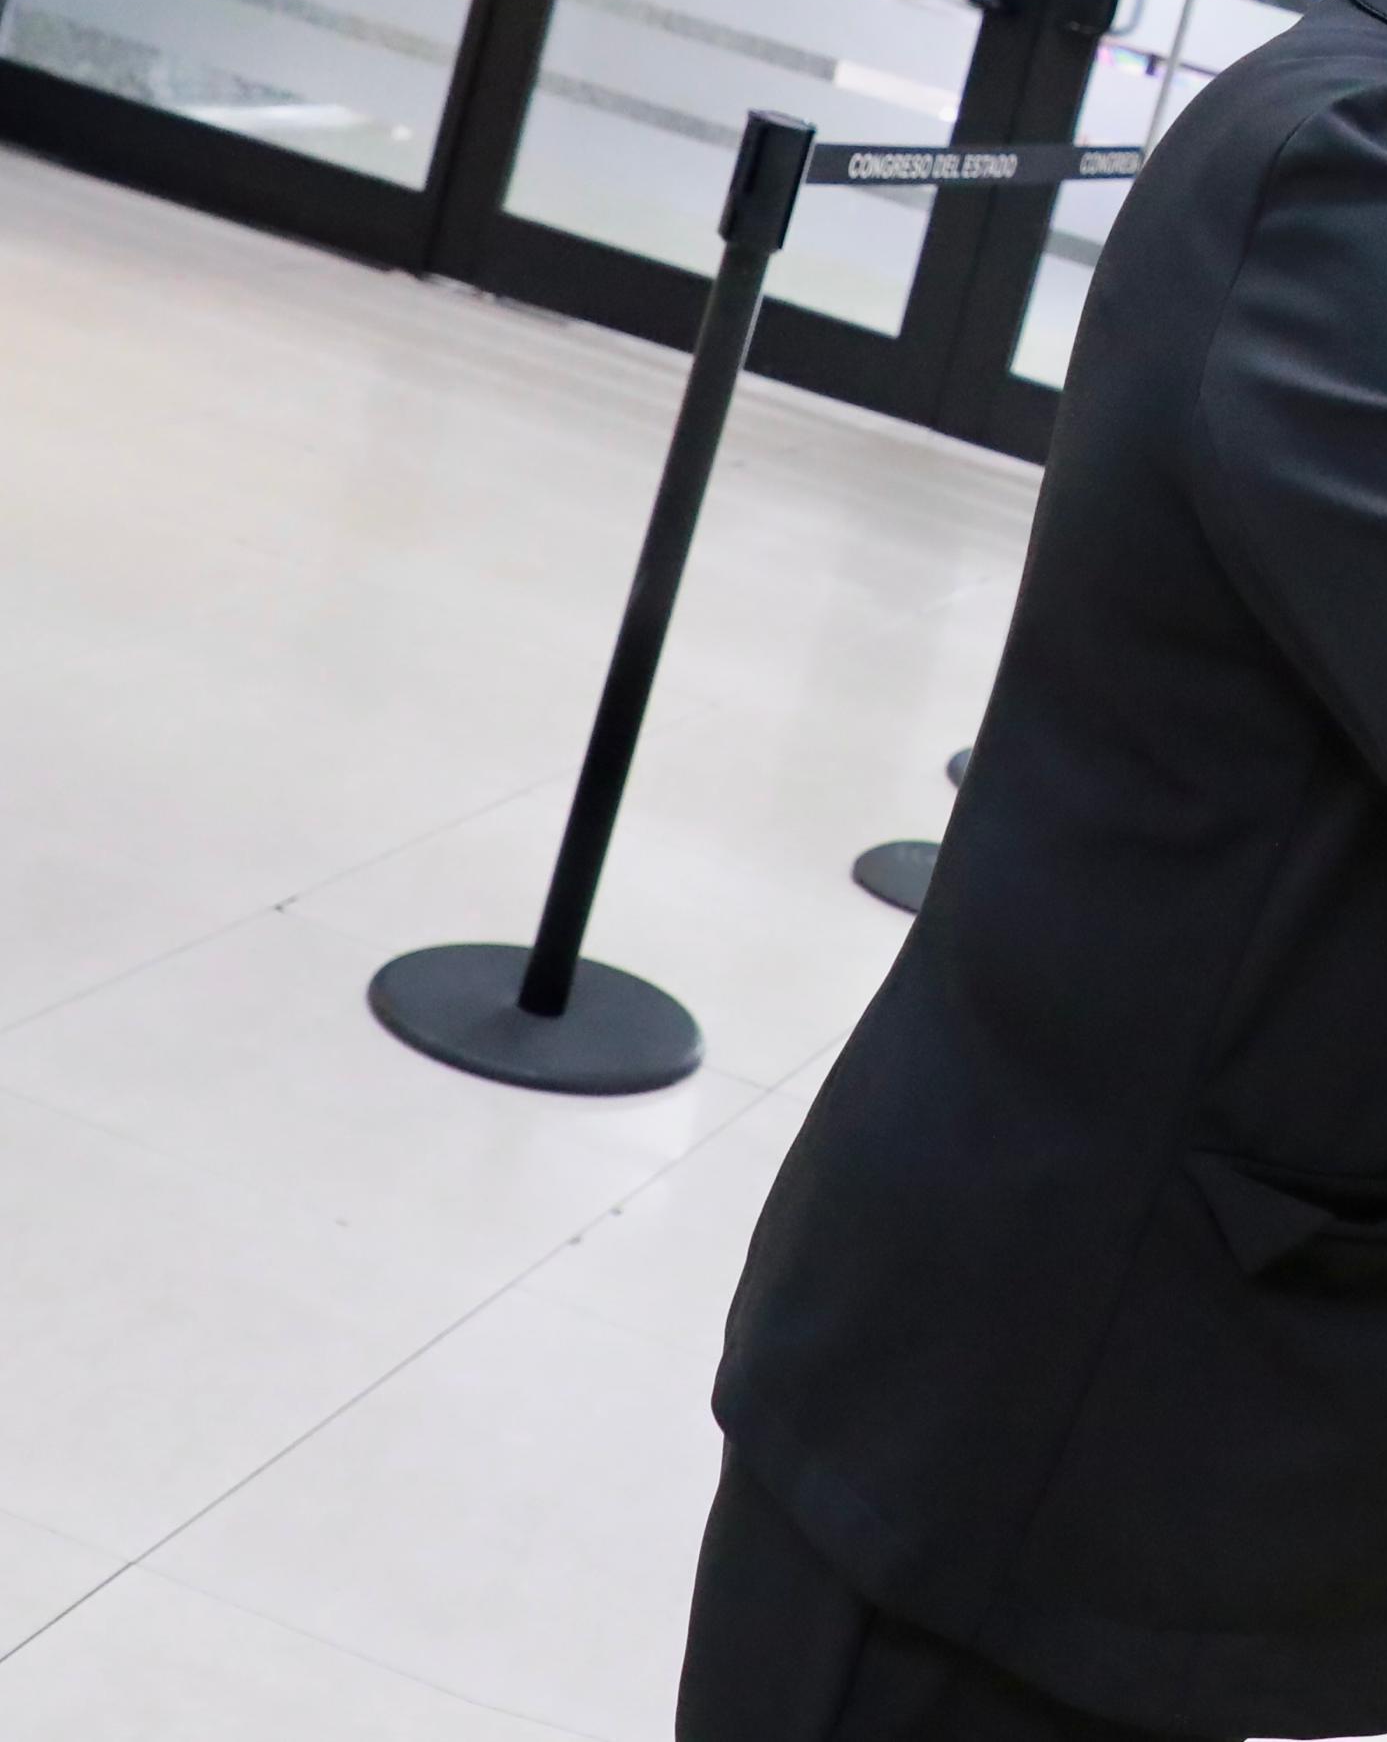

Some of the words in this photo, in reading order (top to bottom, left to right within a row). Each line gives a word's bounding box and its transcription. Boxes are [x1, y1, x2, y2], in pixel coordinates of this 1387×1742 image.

[848, 152, 932, 179] CONGRESO
[932, 153, 960, 179] DEL
[961, 153, 1018, 179] ESTADO
